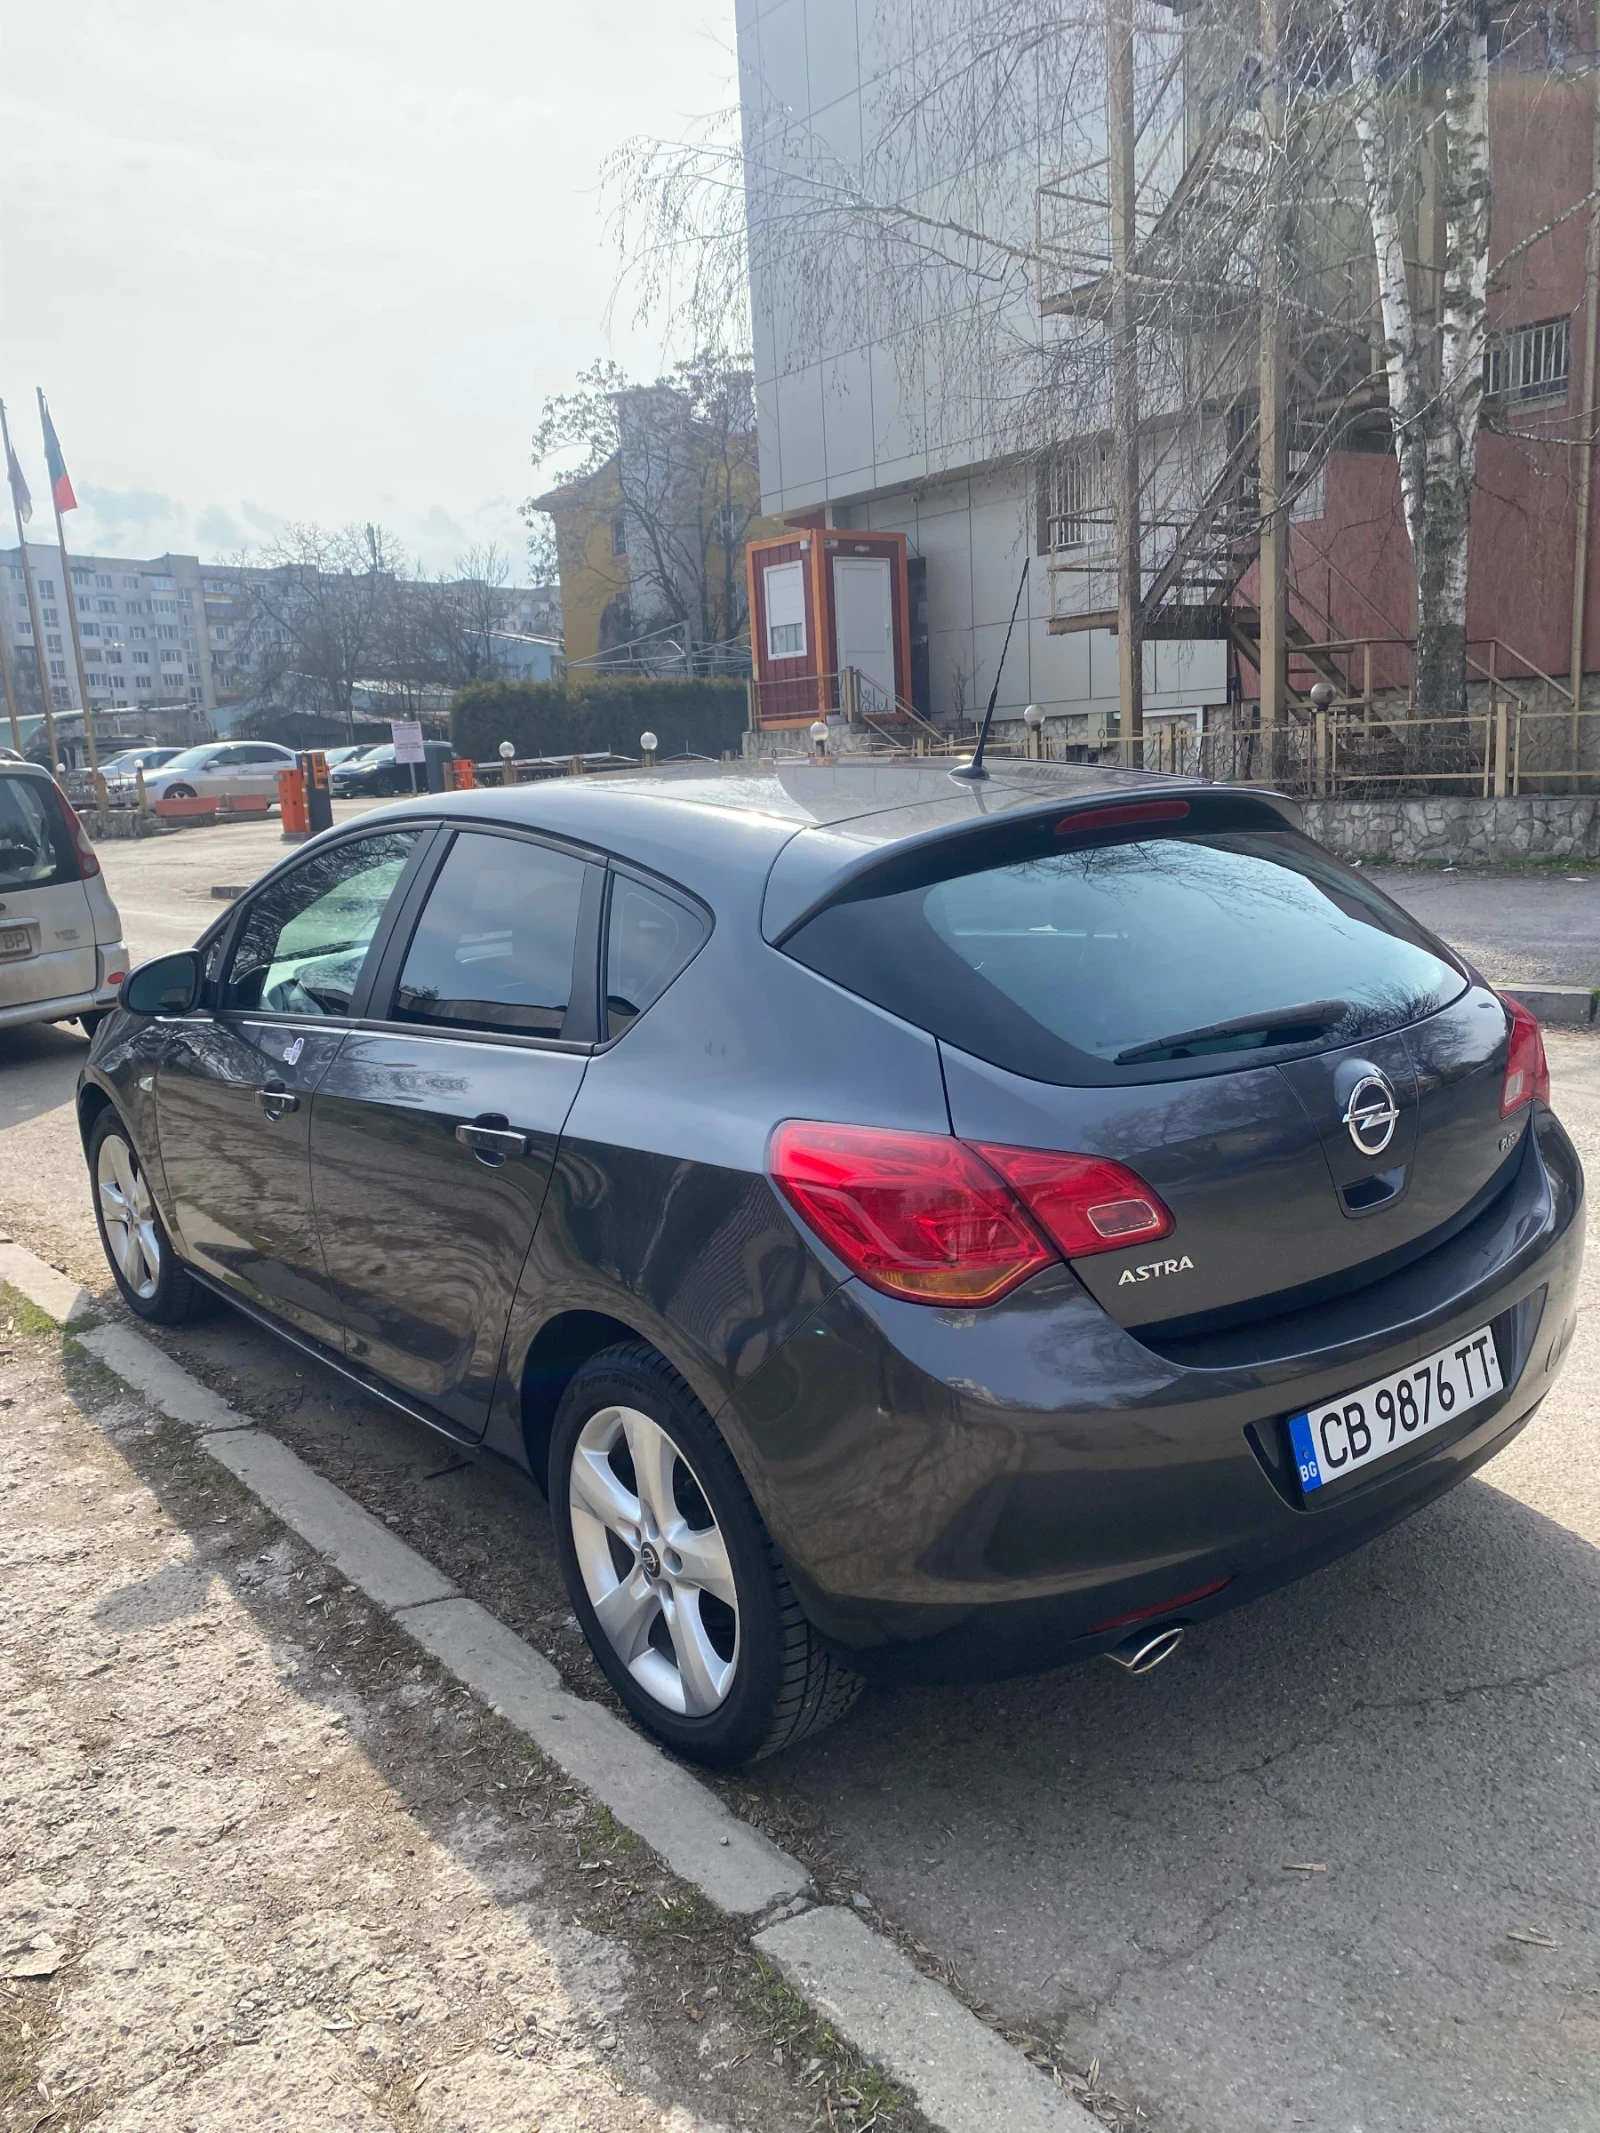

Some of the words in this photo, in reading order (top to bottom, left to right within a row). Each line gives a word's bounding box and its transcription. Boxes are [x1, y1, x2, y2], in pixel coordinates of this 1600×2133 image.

[3, 931, 25, 950] BP
[1118, 1255, 1195, 1286] ASTRA
[1319, 1401, 1372, 1469] CB
[1375, 1359, 1456, 1443] 9876
[1455, 1335, 1492, 1399] TT
[1300, 1460, 1318, 1482] BG
